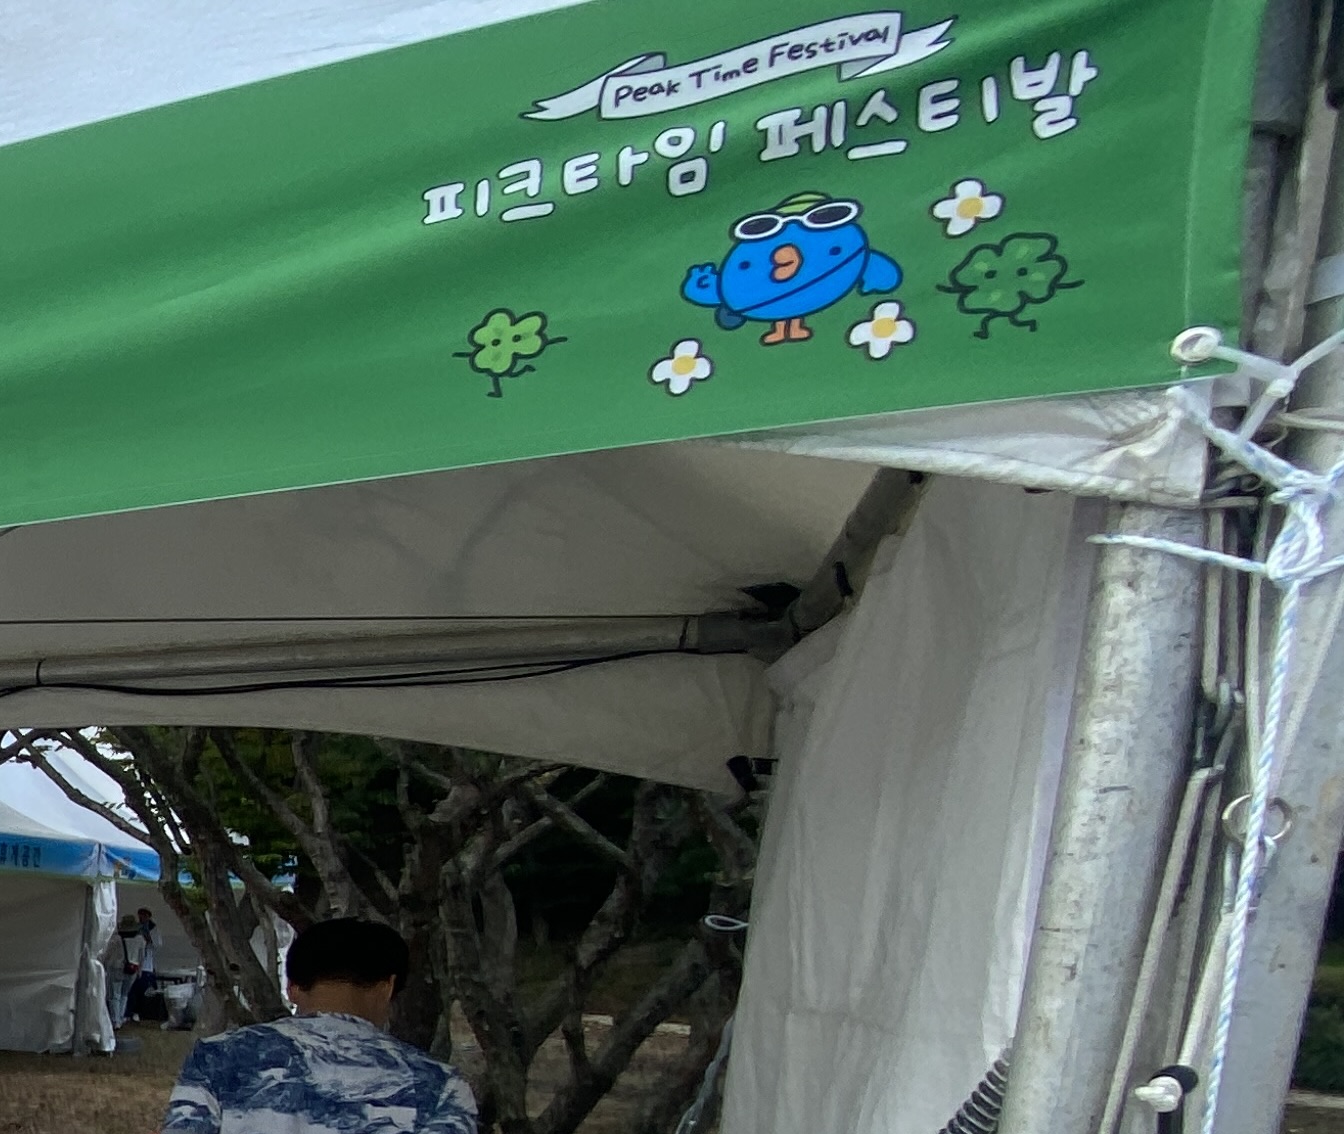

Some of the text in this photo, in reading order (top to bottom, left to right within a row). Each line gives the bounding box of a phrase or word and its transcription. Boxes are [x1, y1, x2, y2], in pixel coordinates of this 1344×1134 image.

[614, 25, 889, 108] Peak Time Festival
[422, 50, 1099, 226] 피크타임 페스티발
